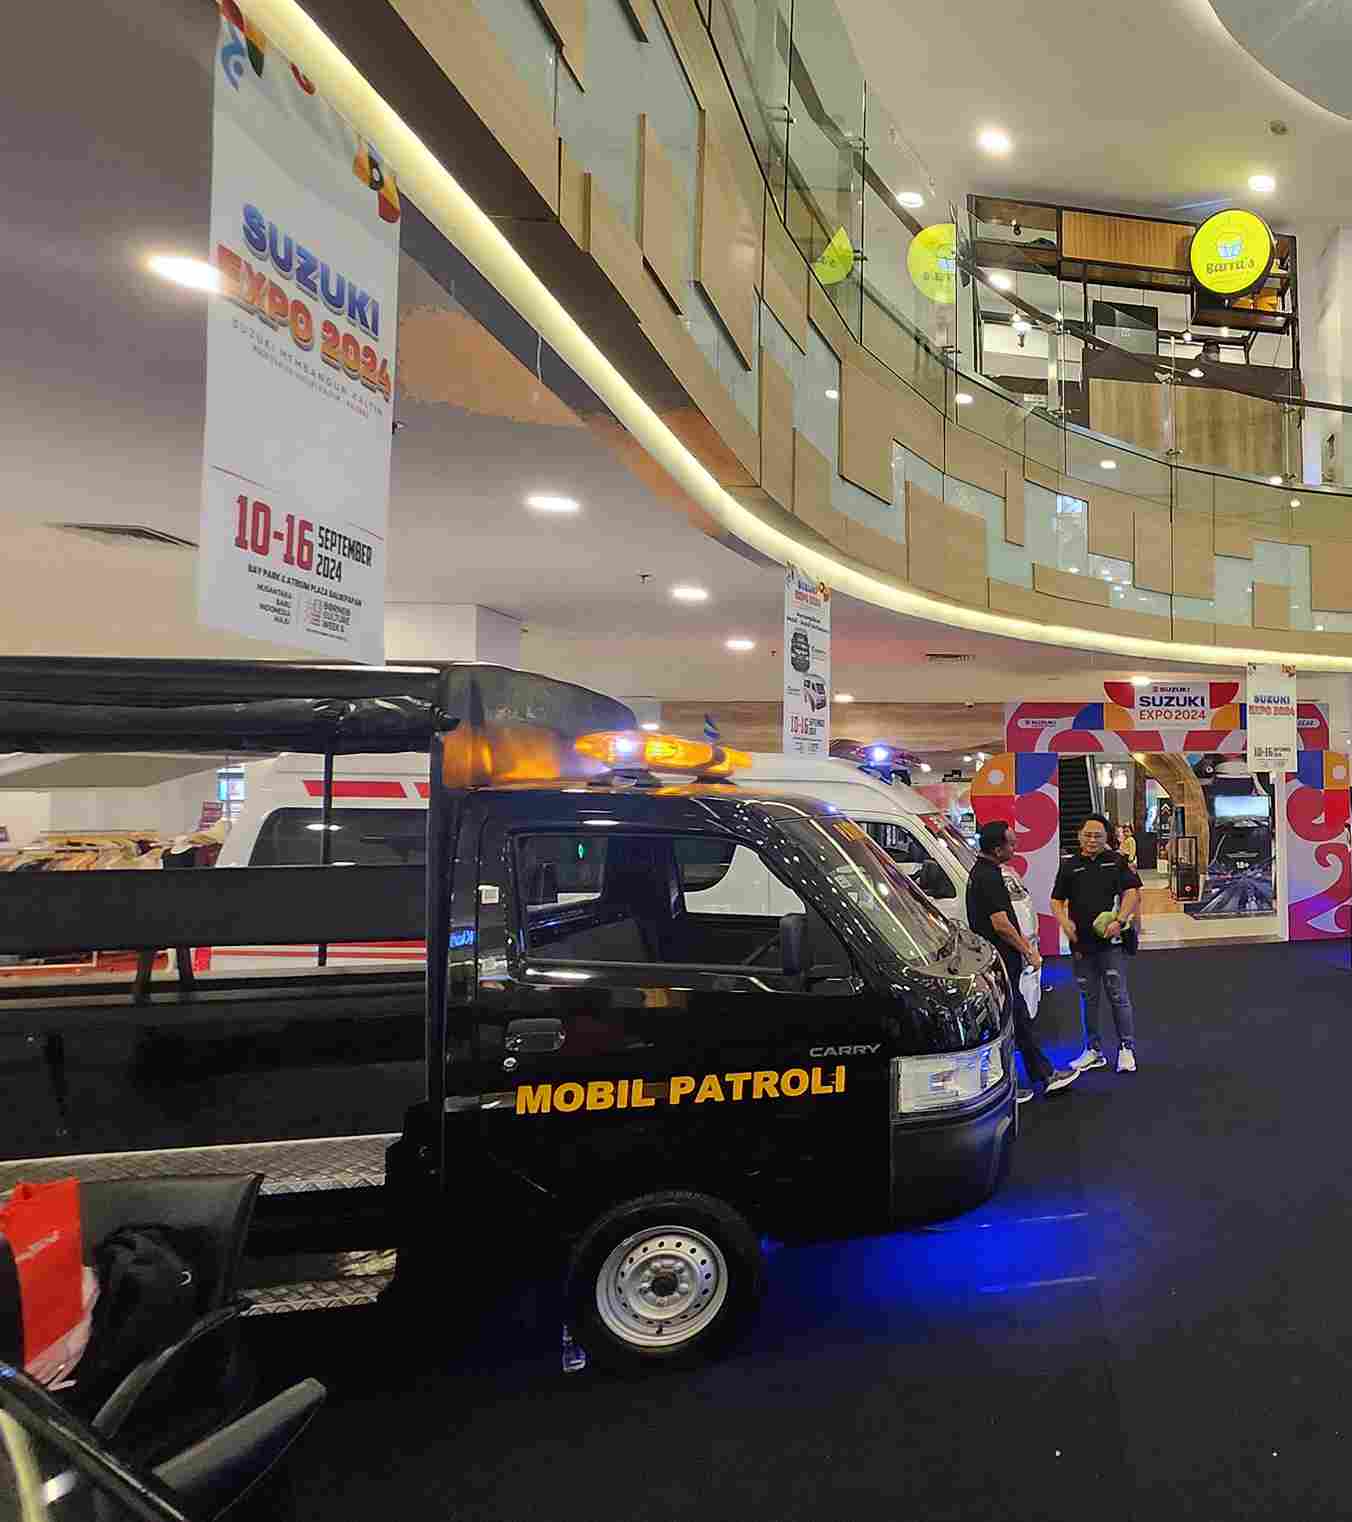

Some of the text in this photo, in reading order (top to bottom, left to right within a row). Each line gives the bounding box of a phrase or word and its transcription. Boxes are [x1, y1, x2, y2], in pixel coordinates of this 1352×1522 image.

[242, 202, 381, 341] SUZUKI
[217, 242, 314, 351] EXPO
[319, 319, 392, 402] 2024
[234, 494, 314, 571] 10-16
[317, 525, 373, 567] SEPTEMBER
[316, 553, 342, 582] 2024
[1138, 695, 1206, 708] SUZUKI
[1138, 709, 1207, 720] EXPO 2024
[1253, 695, 1291, 704] SUZUKI
[809, 1043, 882, 1058] CARRY
[515, 1065, 847, 1115] MOBIL PATROLI
